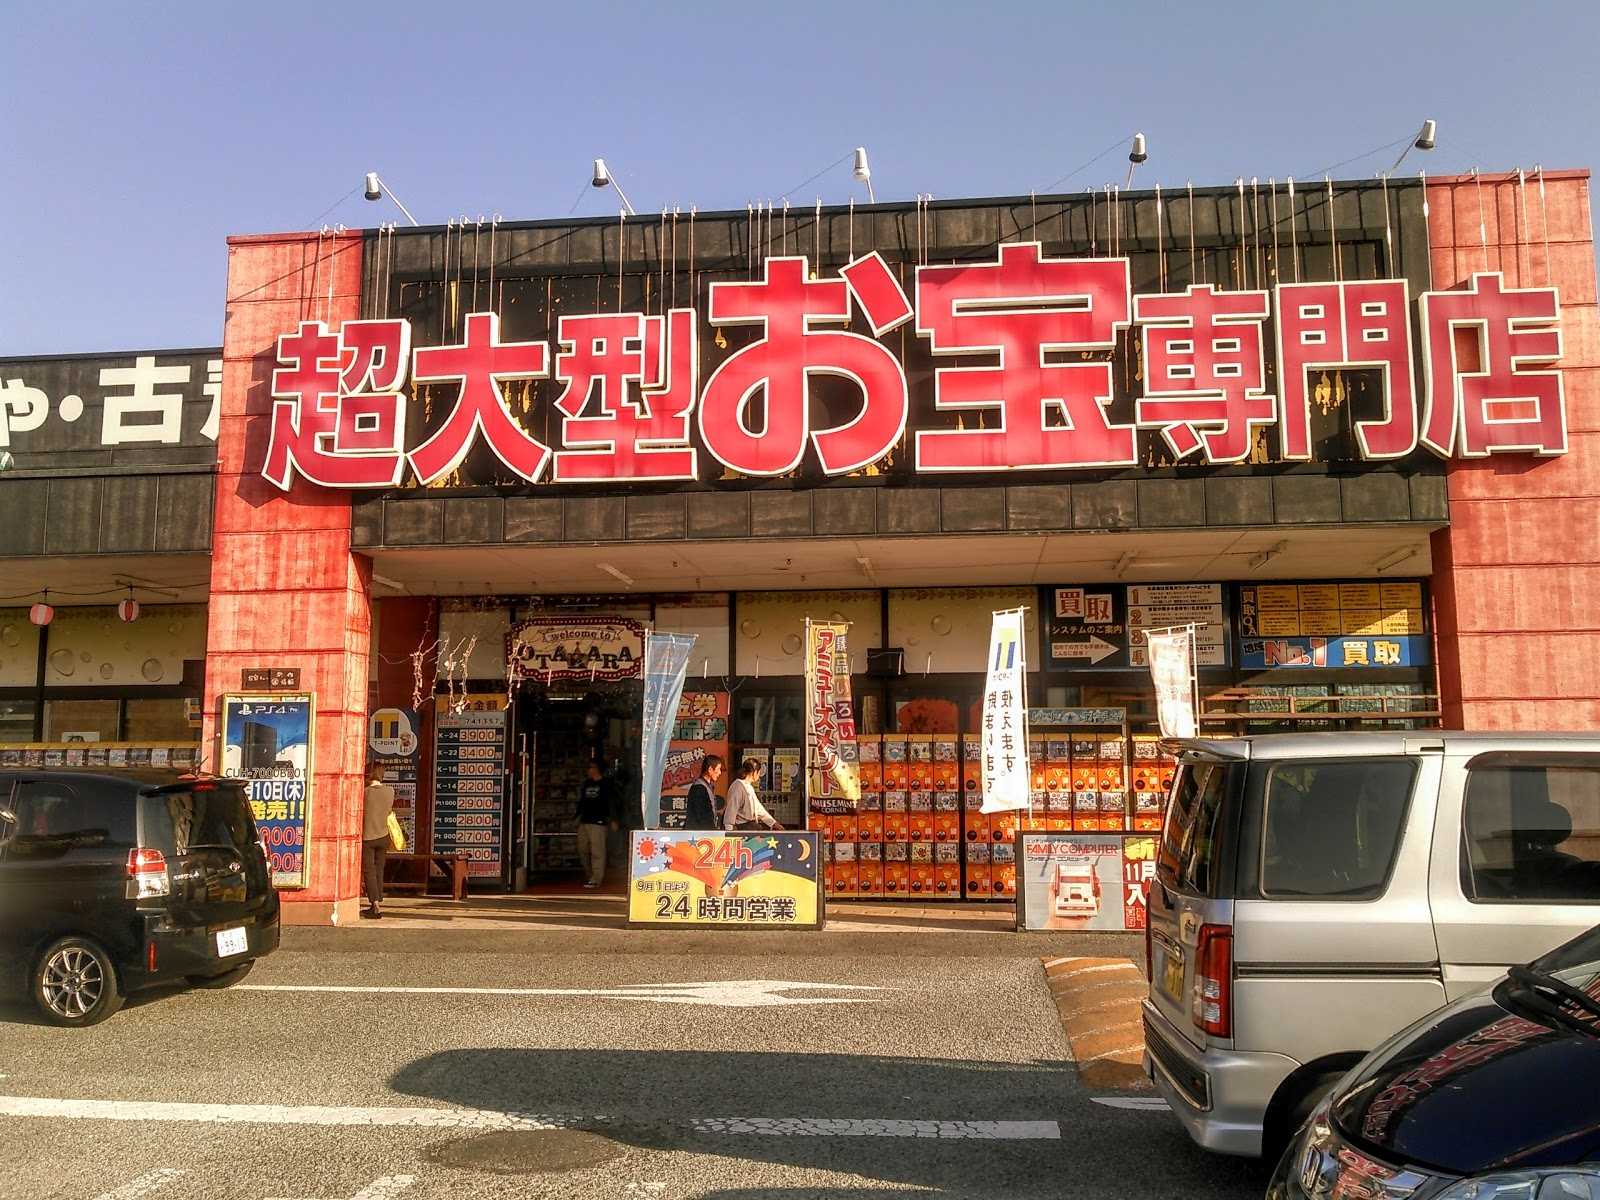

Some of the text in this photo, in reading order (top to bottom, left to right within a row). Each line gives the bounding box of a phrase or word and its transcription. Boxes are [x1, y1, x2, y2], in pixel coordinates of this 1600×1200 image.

[262, 243, 1570, 493] 超大型お宝専門店
[1060, 591, 1110, 621] 買取
[552, 630, 611, 640] welcome to
[1343, 641, 1400, 666] 買取
[255, 706, 286, 714] PS4
[671, 718, 727, 740] 品券
[695, 837, 752, 869] 24h
[1027, 844, 1118, 854] FAMILY COMPUTER
[656, 894, 797, 921] 24時間営業
